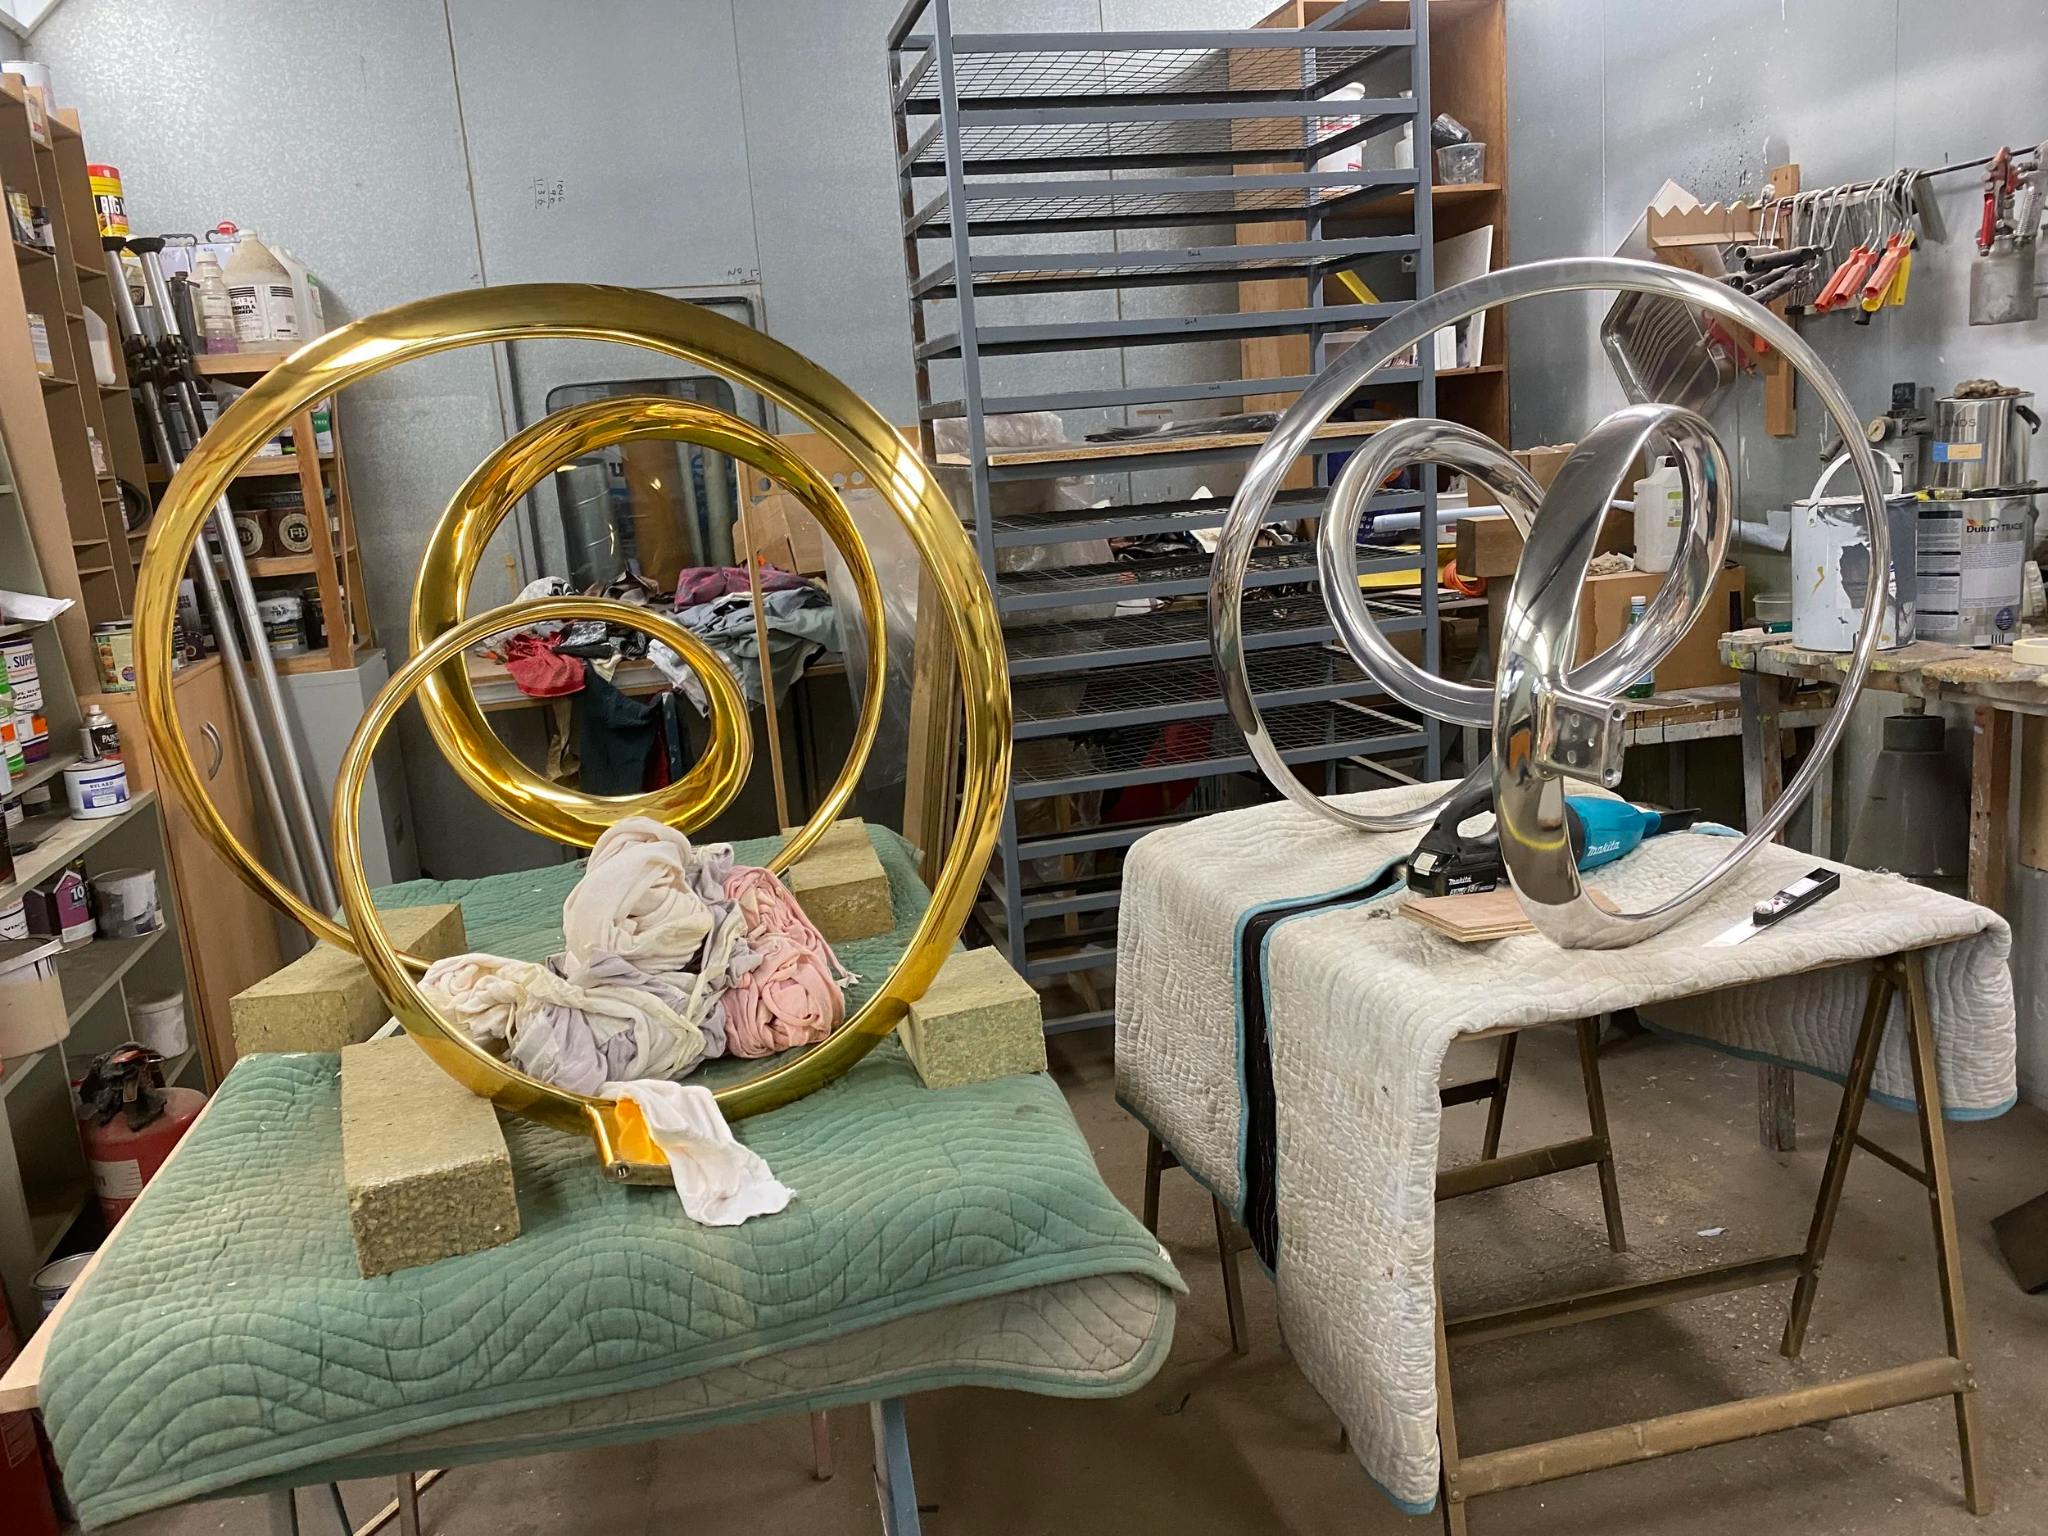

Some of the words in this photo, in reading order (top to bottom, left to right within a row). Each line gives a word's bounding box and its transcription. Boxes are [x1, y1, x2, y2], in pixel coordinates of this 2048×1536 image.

[100, 195, 120, 214] BIG
[1966, 524, 1996, 533] Dulux
[2001, 522, 2024, 531] TRADE
[17, 692, 37, 701] PAINT
[89, 781, 114, 789] RYLARD
[1586, 840, 1620, 857] makita
[1448, 875, 1472, 886] makita
[70, 886, 84, 901] 10
